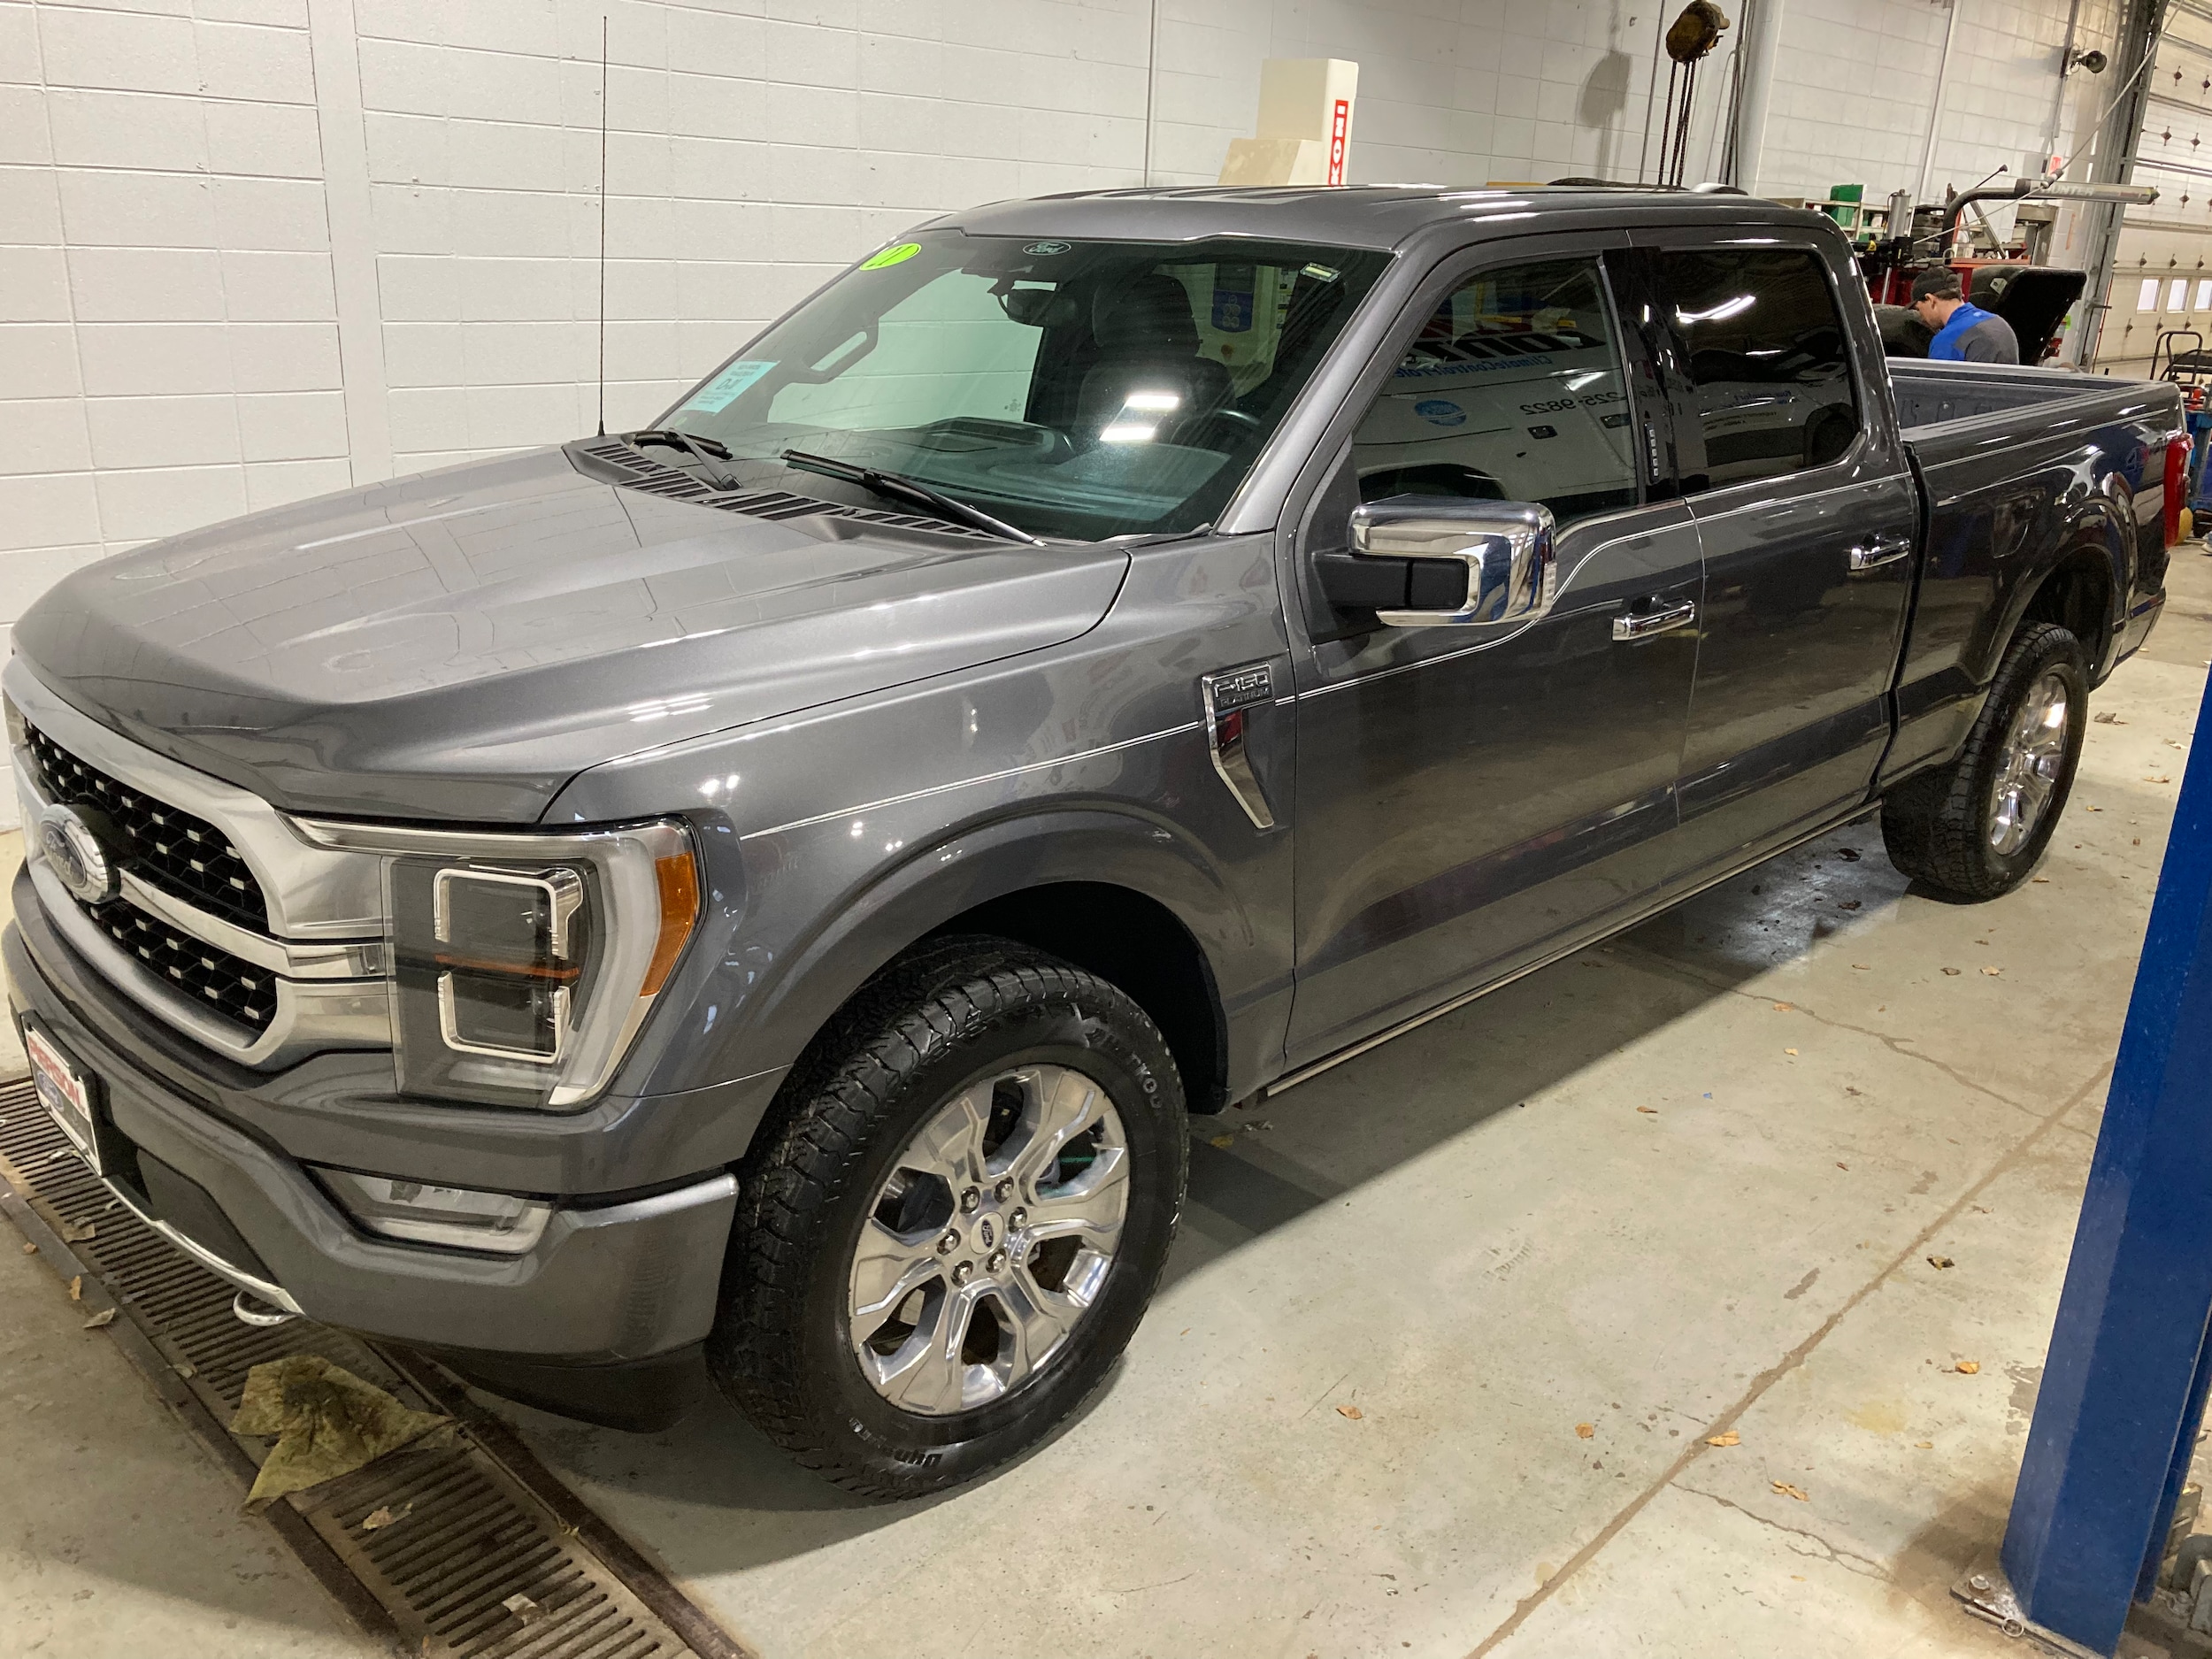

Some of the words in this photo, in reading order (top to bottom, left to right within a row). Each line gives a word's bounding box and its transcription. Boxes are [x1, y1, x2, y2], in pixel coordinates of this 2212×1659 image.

[1028, 242, 1064, 254] Ford
[1214, 671, 1269, 698] F-150
[46, 830, 74, 879] Ford
[982, 1225, 992, 1244] Ford
